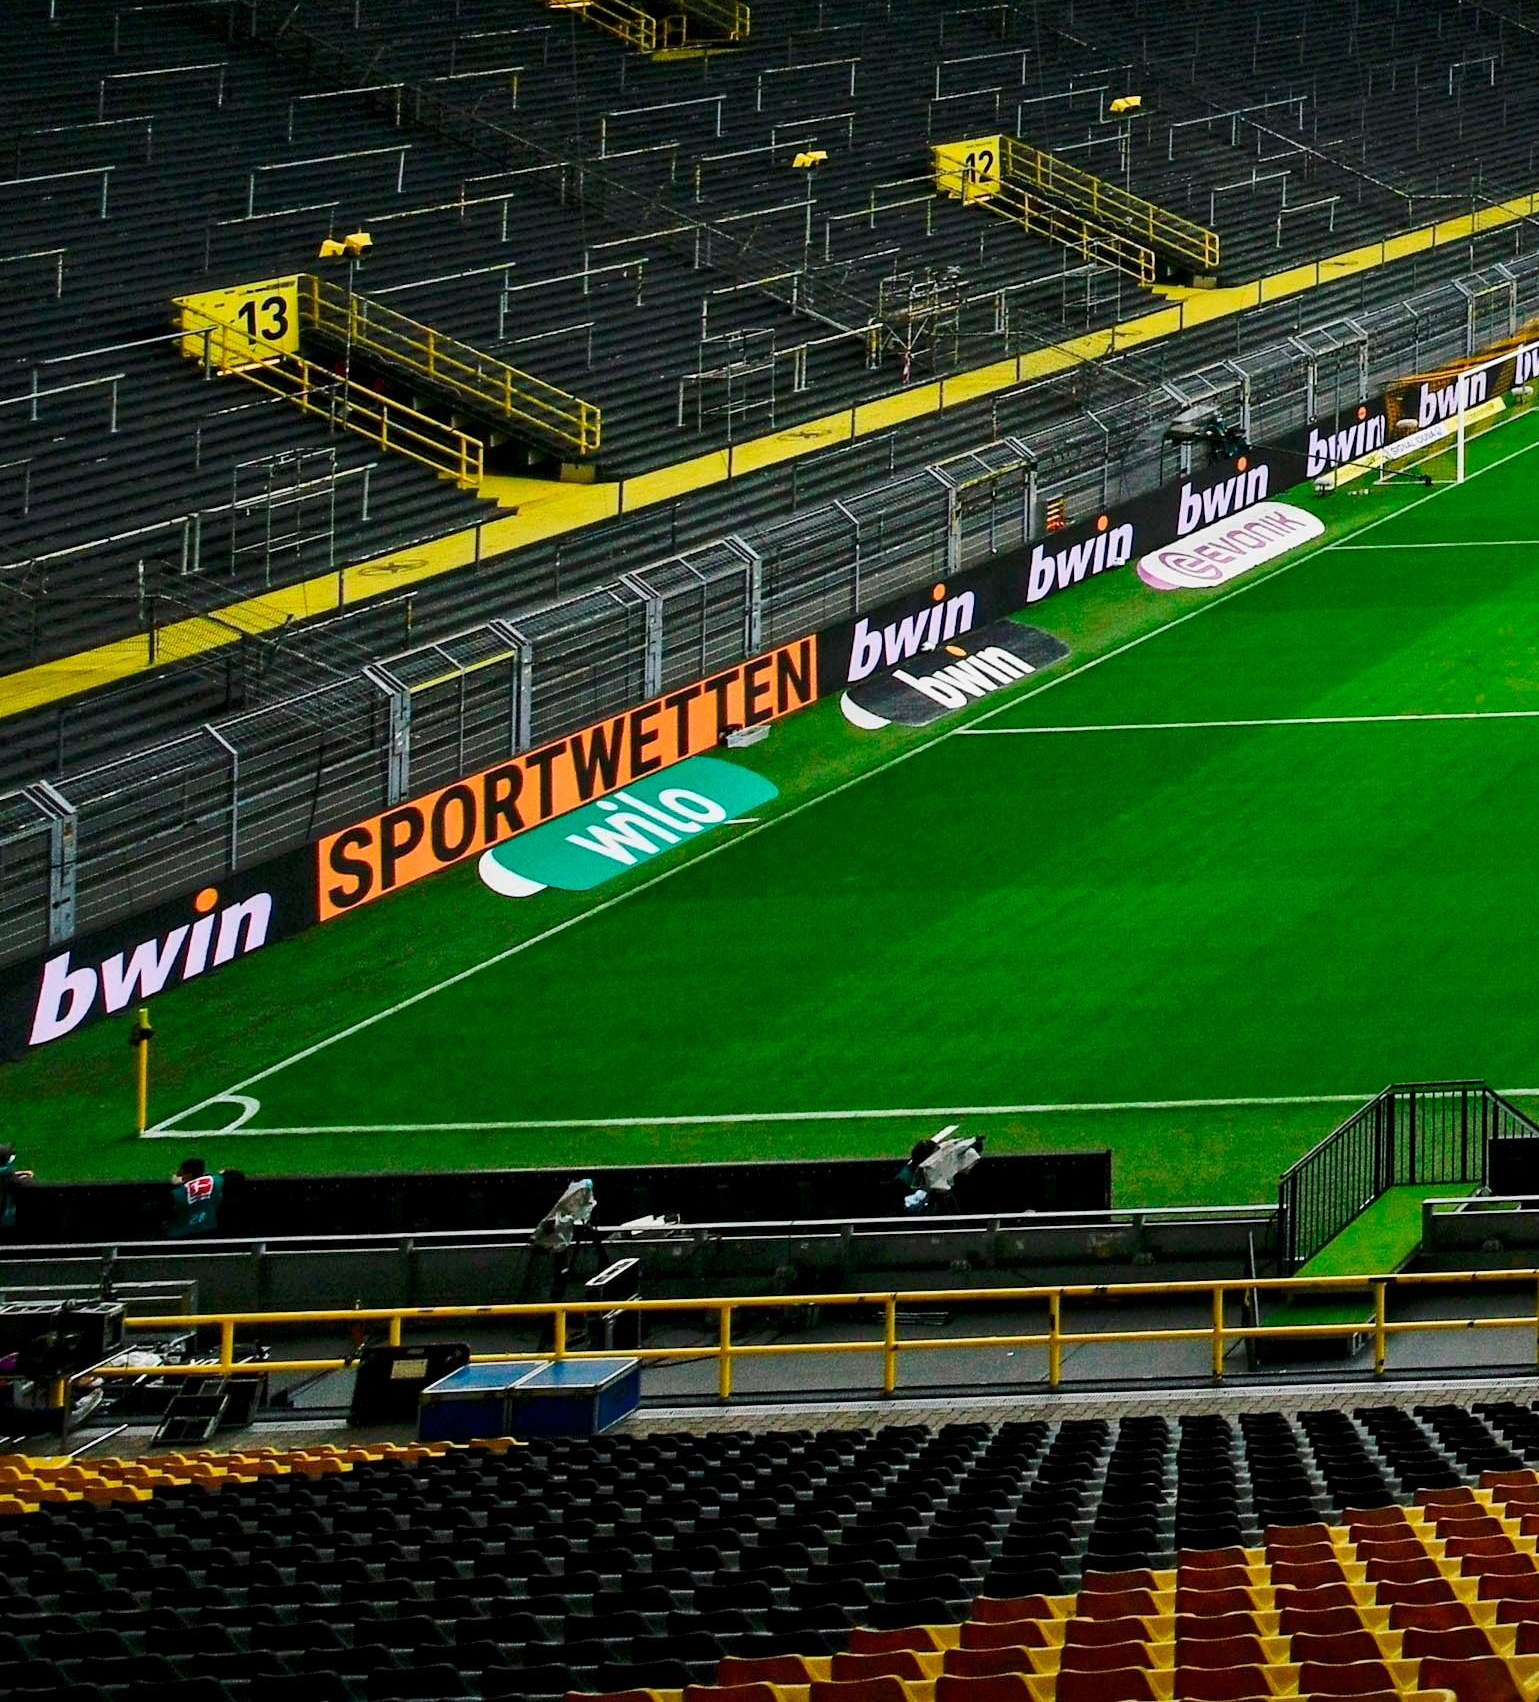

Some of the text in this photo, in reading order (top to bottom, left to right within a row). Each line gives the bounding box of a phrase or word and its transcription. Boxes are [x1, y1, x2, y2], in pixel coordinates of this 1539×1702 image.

[964, 149, 995, 183] 12
[238, 295, 289, 345] 13
[1177, 456, 1270, 536] bwin
[1027, 514, 1134, 599] bwin
[846, 582, 977, 683] bwin
[892, 640, 1036, 709] bwin
[326, 638, 813, 910] SPORTWETTEN
[564, 783, 727, 868] wilo
[28, 888, 272, 1046] bwin
